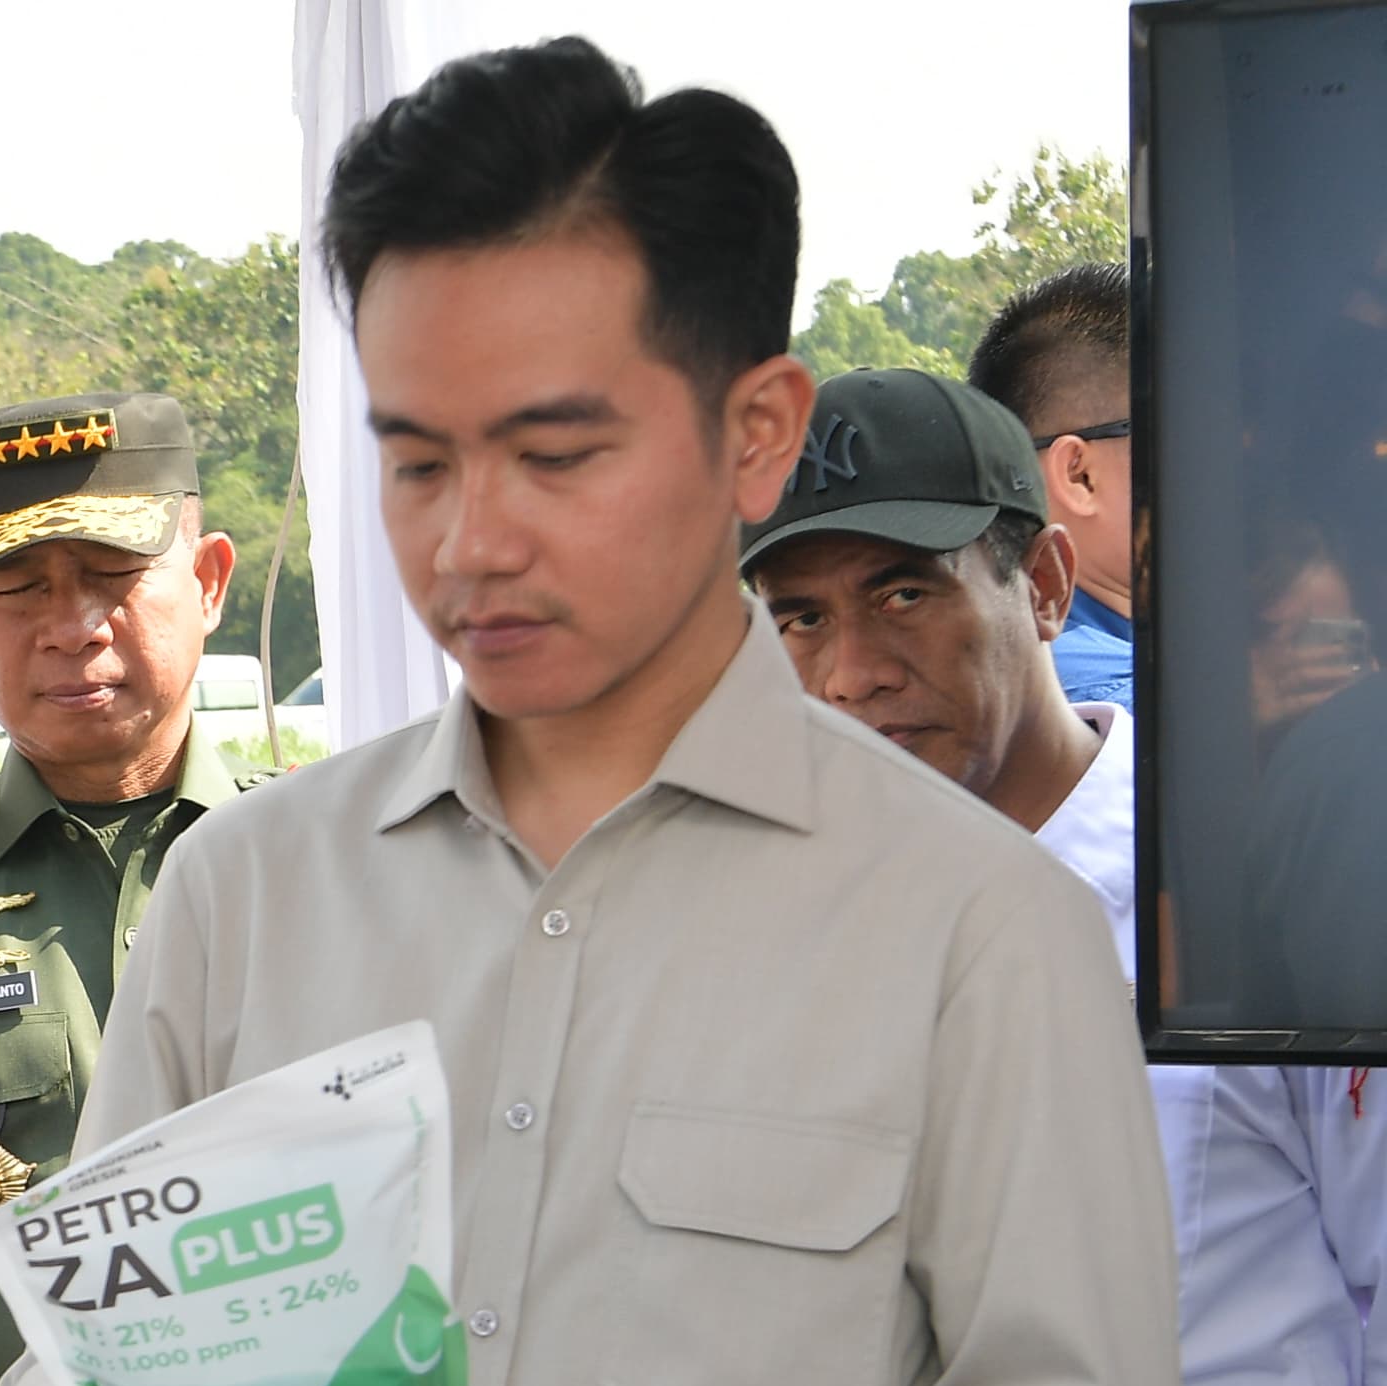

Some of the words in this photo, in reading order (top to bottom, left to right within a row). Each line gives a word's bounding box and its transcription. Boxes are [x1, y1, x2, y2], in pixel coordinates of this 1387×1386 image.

[16, 1175, 202, 1252] PETRO
[27, 1243, 173, 1312] ZA
[178, 1203, 335, 1277] PLUS
[114, 1315, 186, 1348] 21%
[225, 1298, 250, 1325] S
[278, 1269, 360, 1312] 24%
[197, 1335, 261, 1365] ppm
